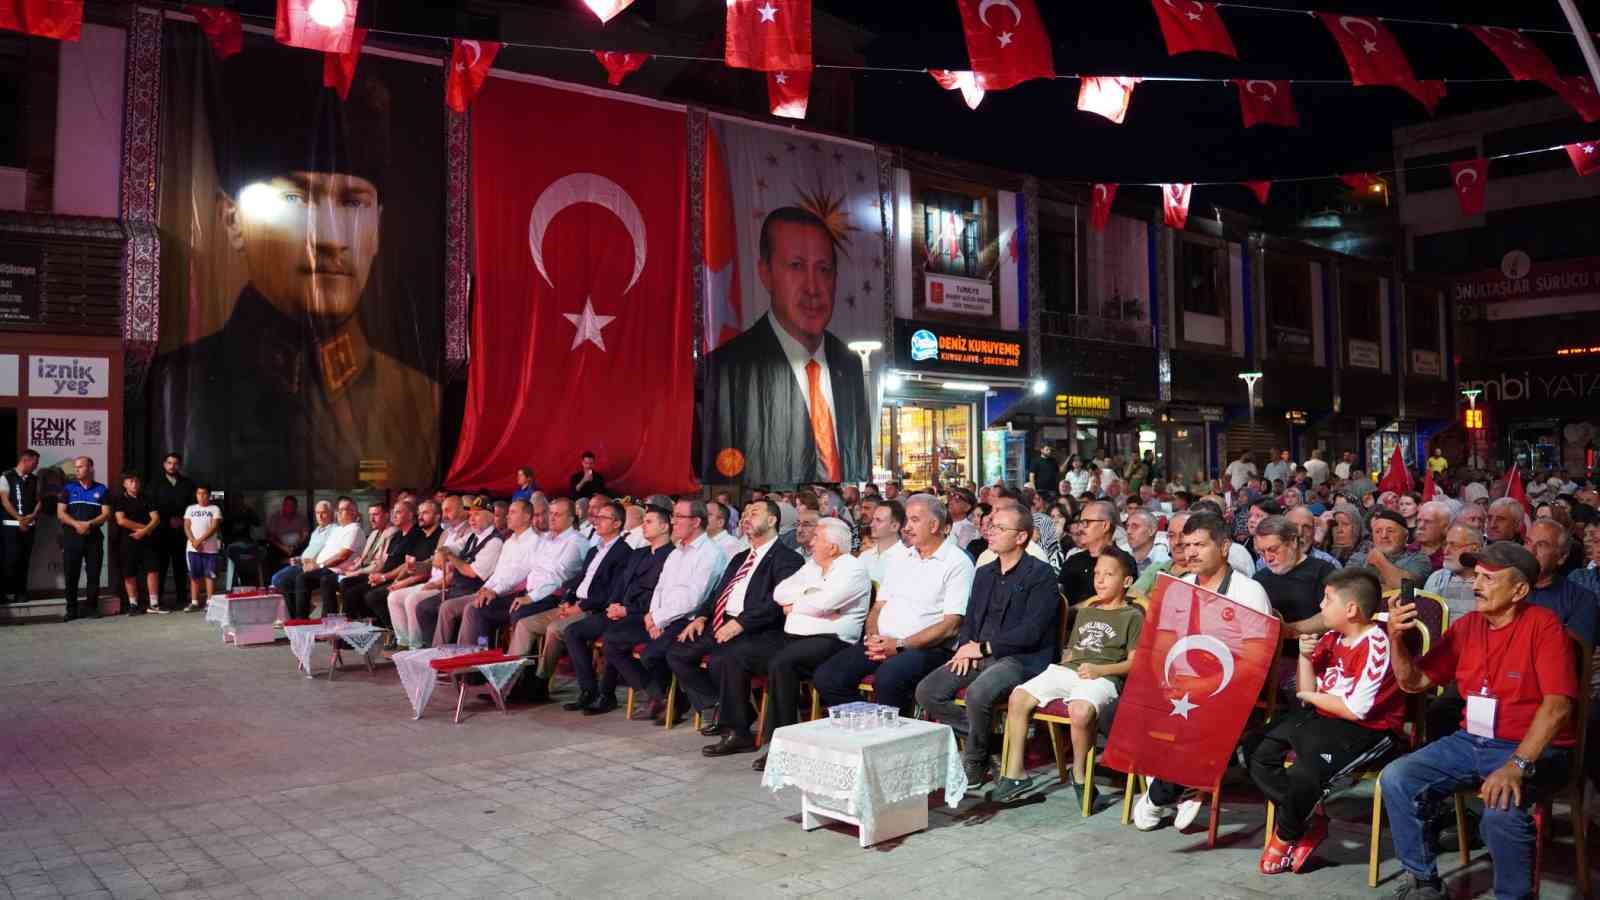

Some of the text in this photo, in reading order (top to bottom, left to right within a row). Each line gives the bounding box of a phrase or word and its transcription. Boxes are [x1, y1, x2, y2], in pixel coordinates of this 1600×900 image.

[939, 335, 968, 352] DENİZ
[38, 358, 96, 384] iznik
[53, 380, 90, 395] yeg
